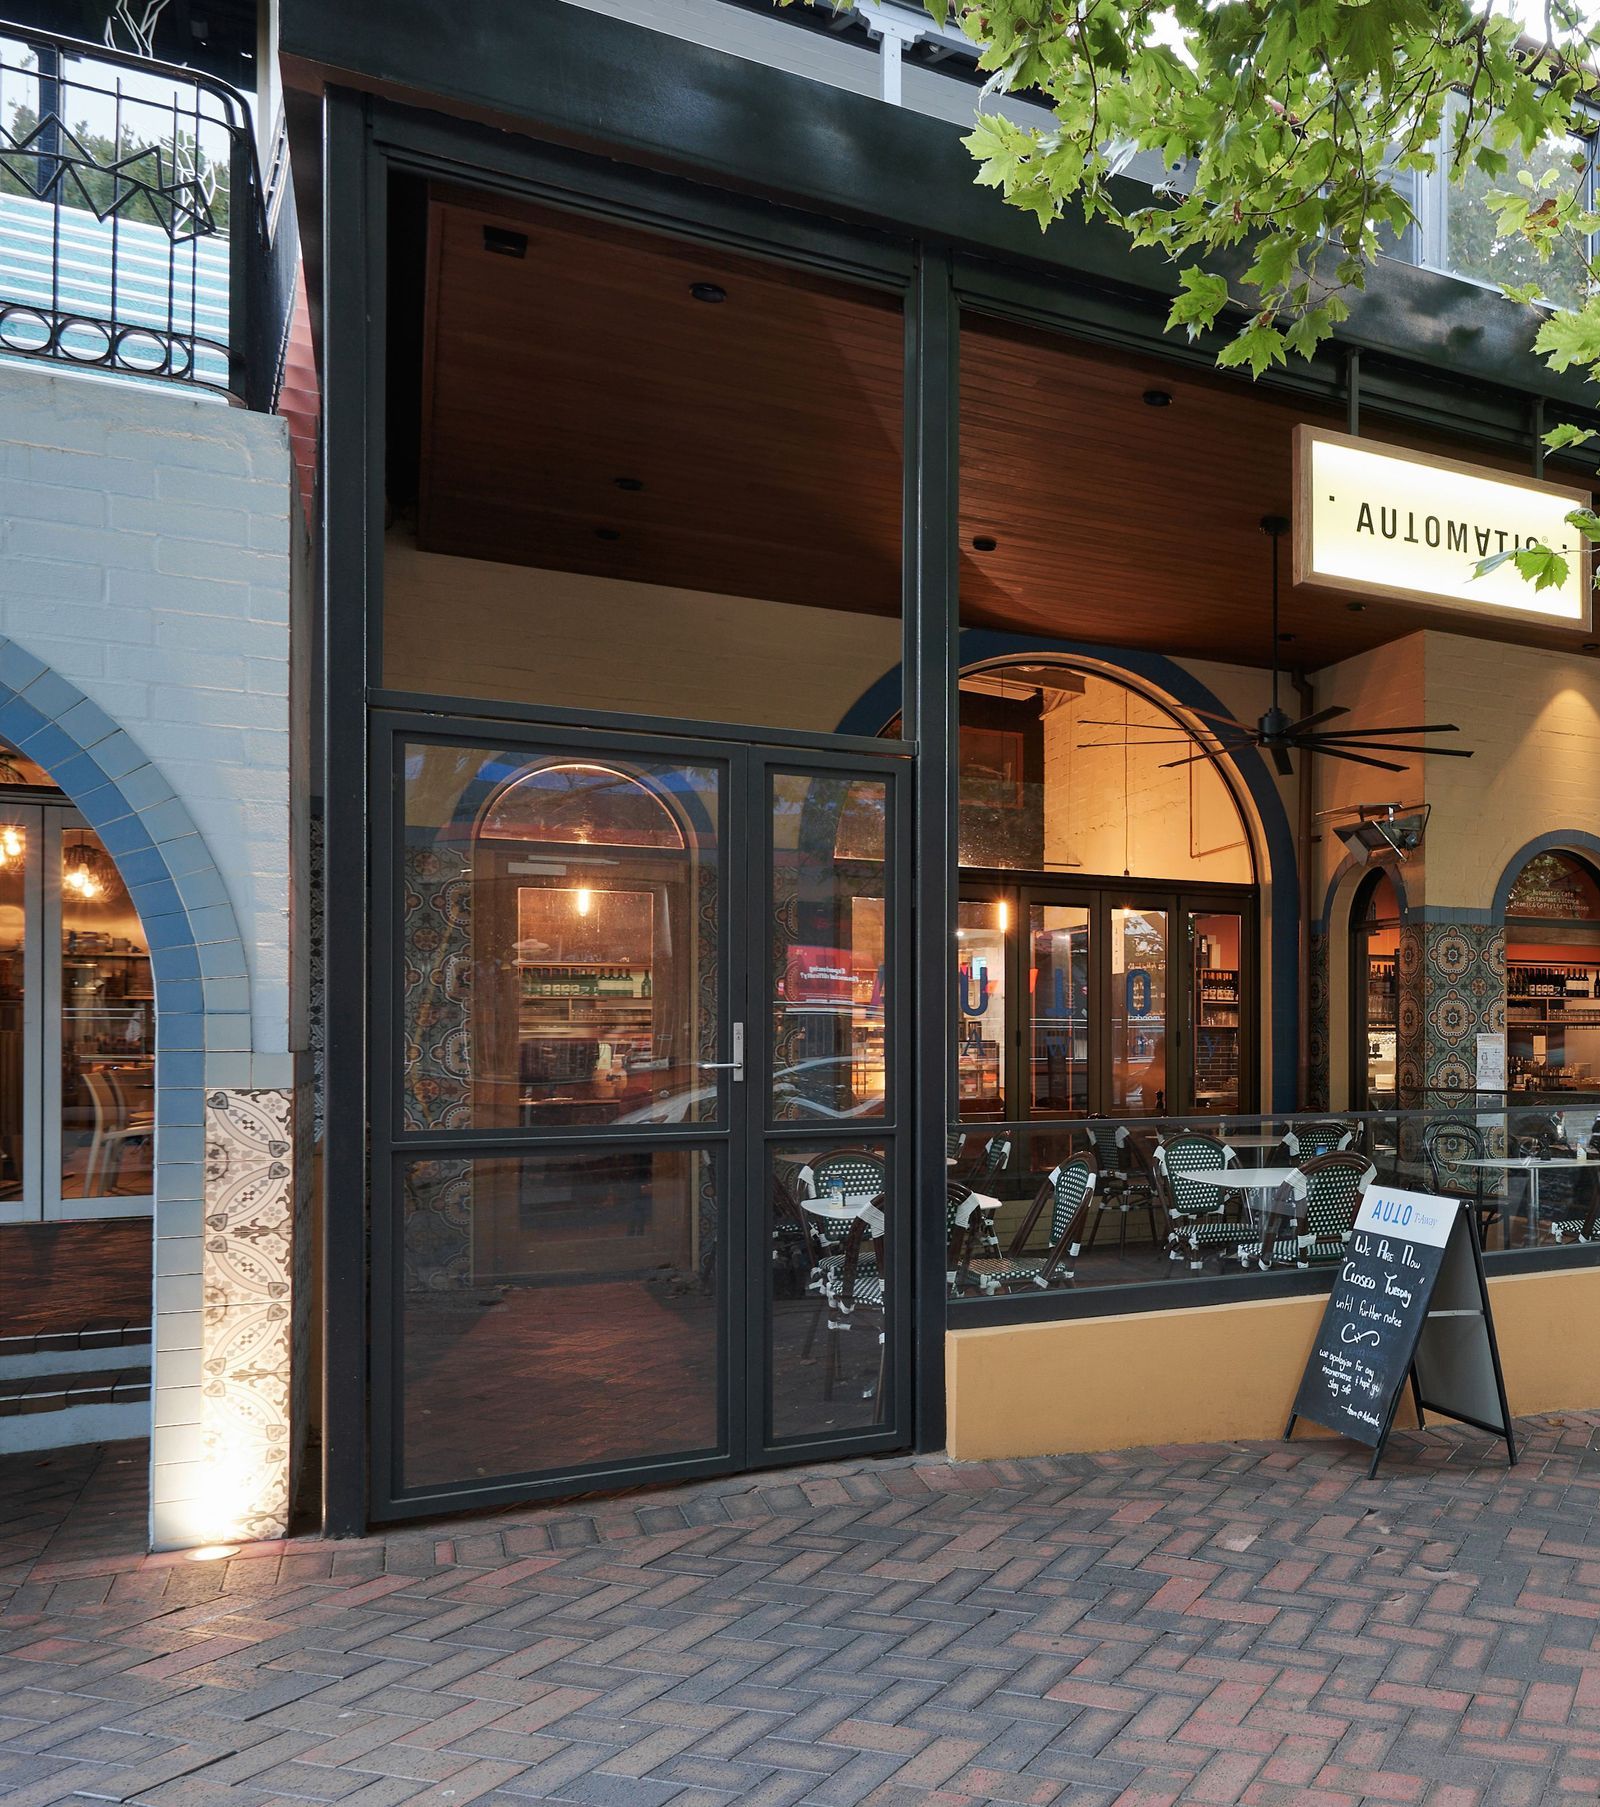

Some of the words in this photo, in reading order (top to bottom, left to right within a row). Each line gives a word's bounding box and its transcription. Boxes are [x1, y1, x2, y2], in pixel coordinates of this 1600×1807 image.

[1371, 1199, 1413, 1226] AUTO
[1335, 1294, 1354, 1313] until
[1358, 1299, 1382, 1321] further
[1383, 1309, 1402, 1328] notice
[1355, 1359, 1364, 1372] for
[1364, 1367, 1375, 1383] any
[1340, 1383, 1353, 1396] safe
[1358, 1376, 1371, 1391] hope
[1369, 1382, 1381, 1397] you
